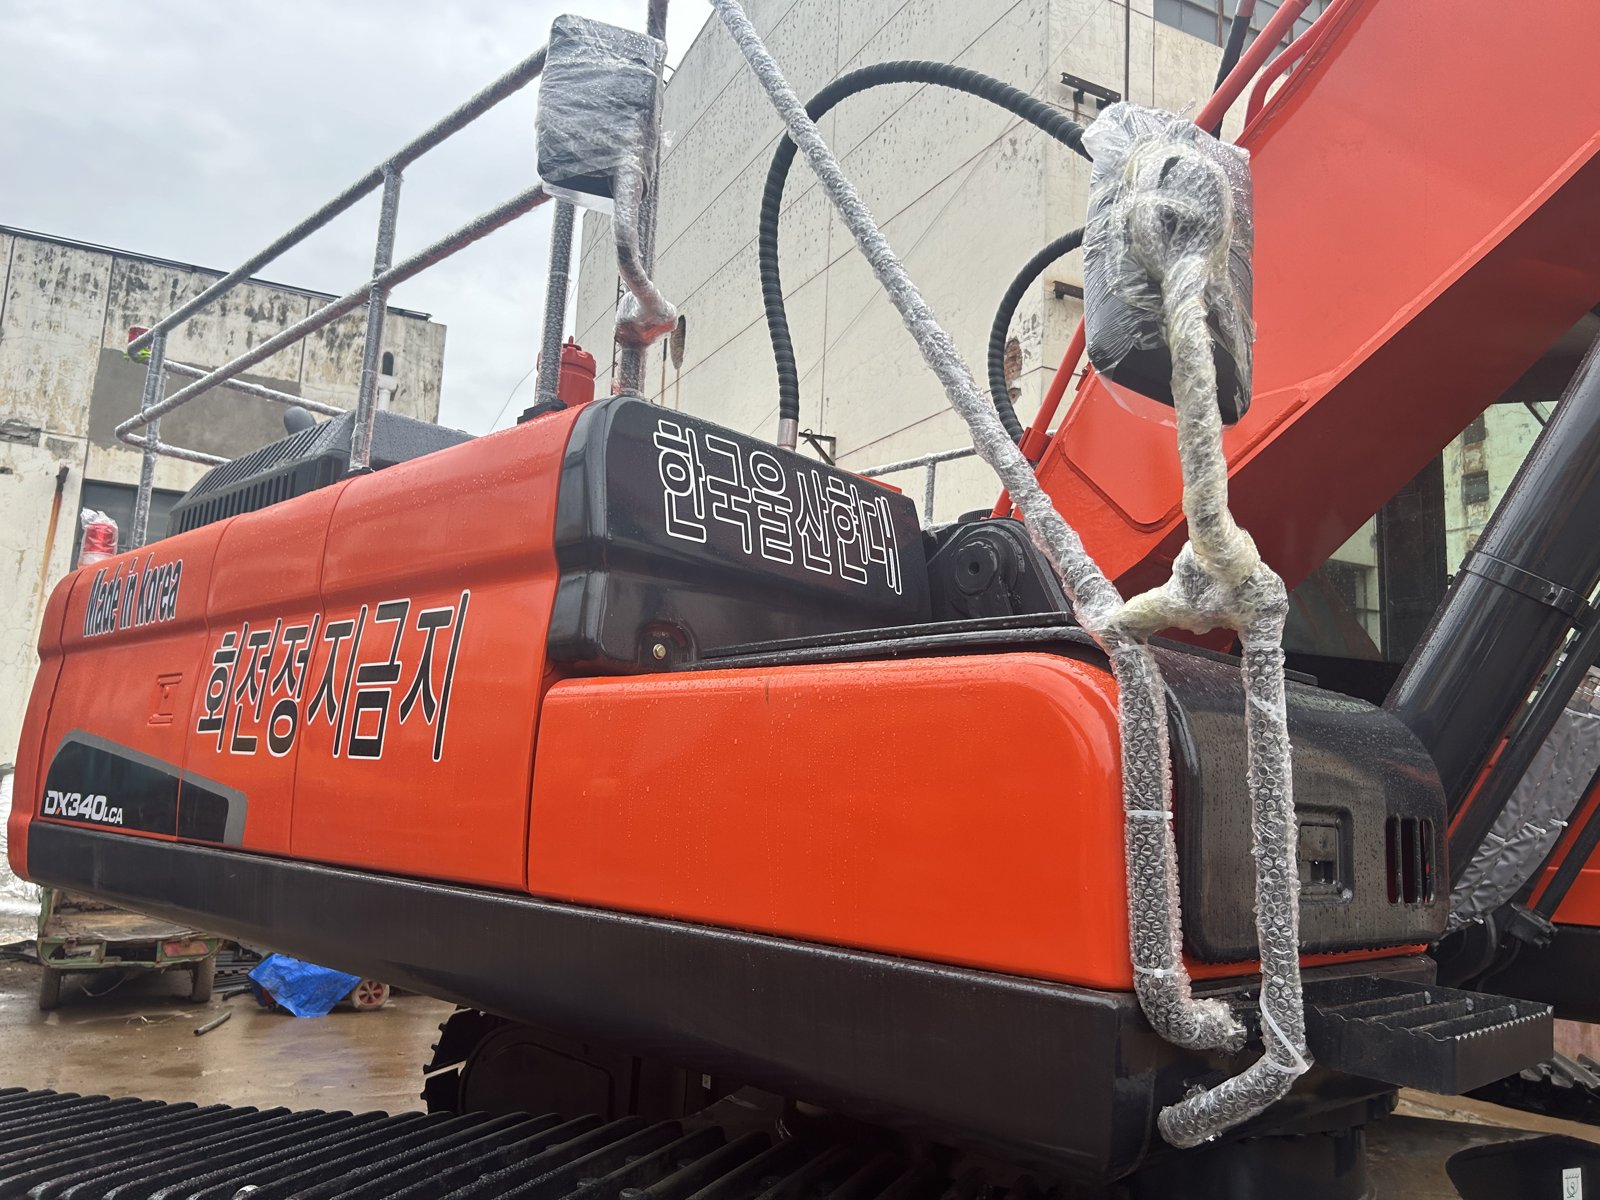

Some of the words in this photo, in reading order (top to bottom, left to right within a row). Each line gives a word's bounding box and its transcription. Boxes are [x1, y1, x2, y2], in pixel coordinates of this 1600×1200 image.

[83, 562, 123, 637] Made
[120, 556, 139, 630] in
[197, 589, 470, 762] 회전정지금지
